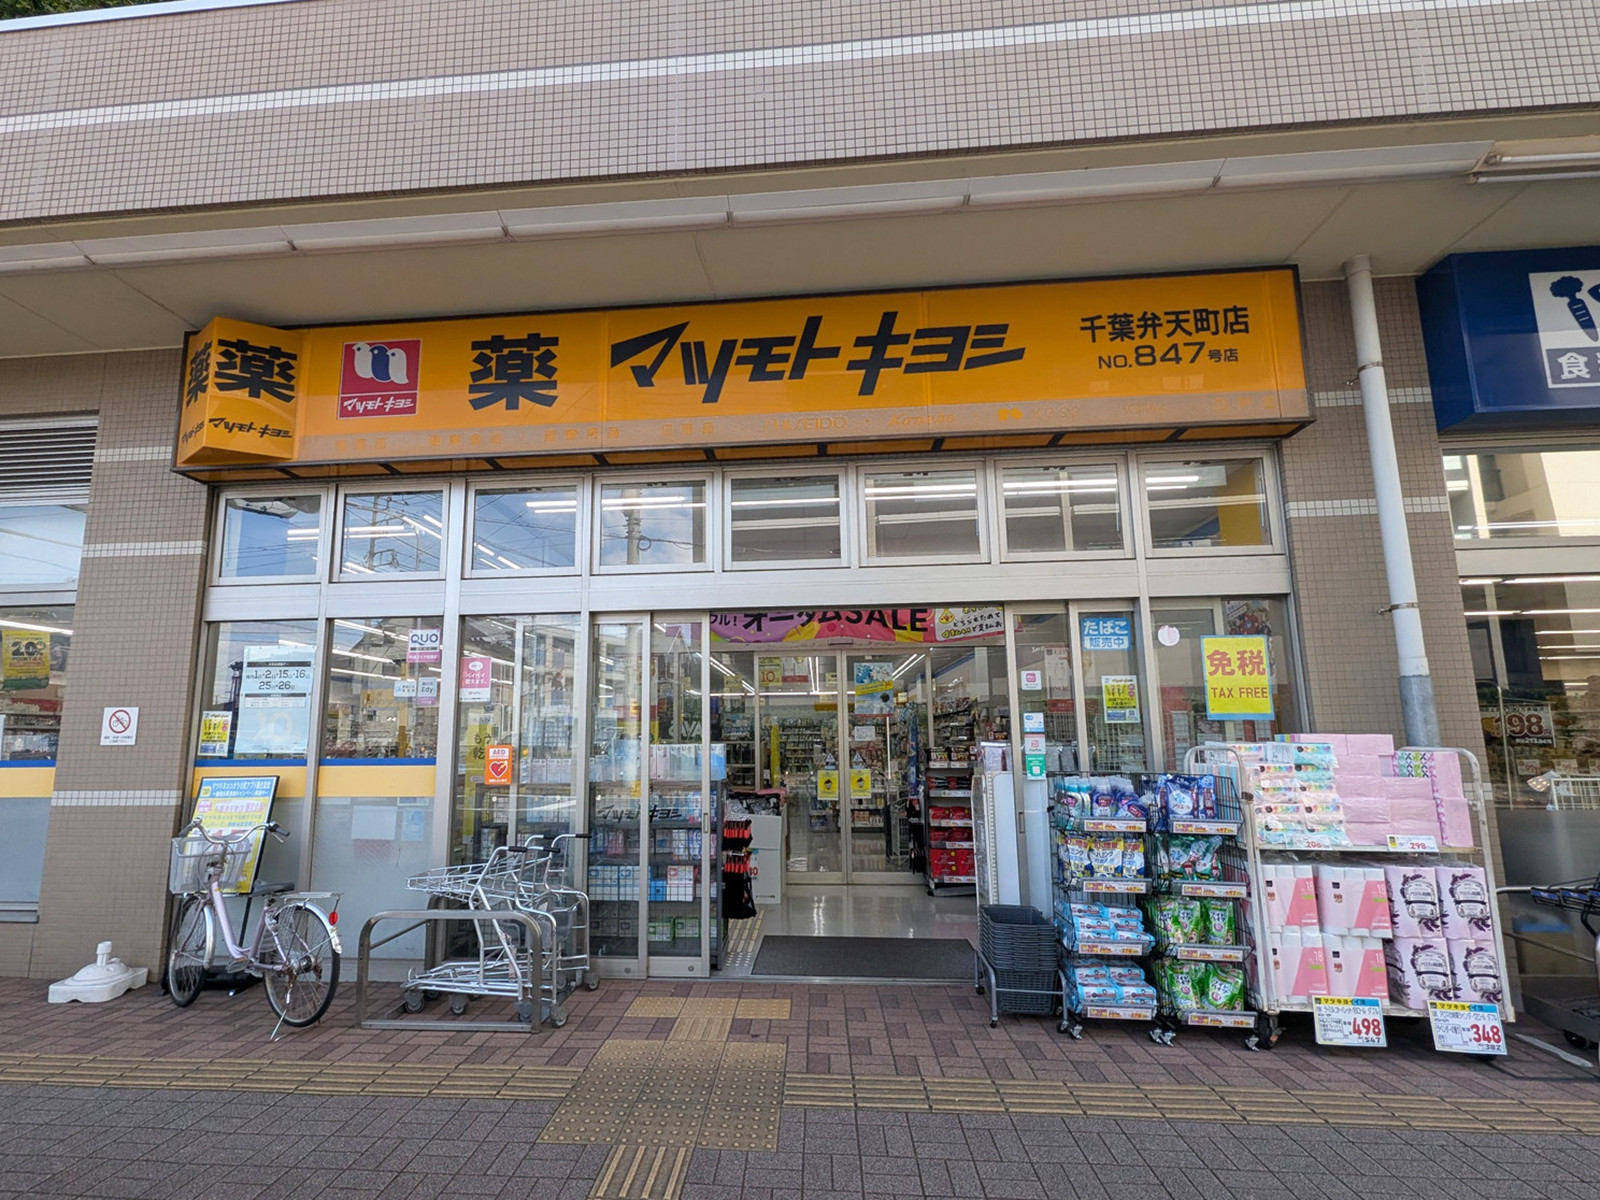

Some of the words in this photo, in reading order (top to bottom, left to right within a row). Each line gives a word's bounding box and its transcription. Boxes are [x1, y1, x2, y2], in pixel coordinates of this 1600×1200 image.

[1080, 305, 1249, 343] 千葉弁天町店
[611, 312, 1025, 404] マツモトキヨシ
[1557, 352, 1600, 380] 食
[214, 338, 297, 403] 薬
[469, 333, 559, 411] 薬
[343, 396, 414, 411] マツモトキヨシ
[209, 417, 292, 438] マツモトキヨシ
[1083, 620, 1128, 635] たばこ
[411, 633, 438, 645] QUO
[1090, 637, 1124, 648] 販売中
[1206, 650, 1266, 676] 免税
[1211, 687, 1234, 699] TAX
[1239, 687, 1269, 699] FREE
[1353, 1017, 1382, 1037] 498
[1470, 1023, 1502, 1044] 348
